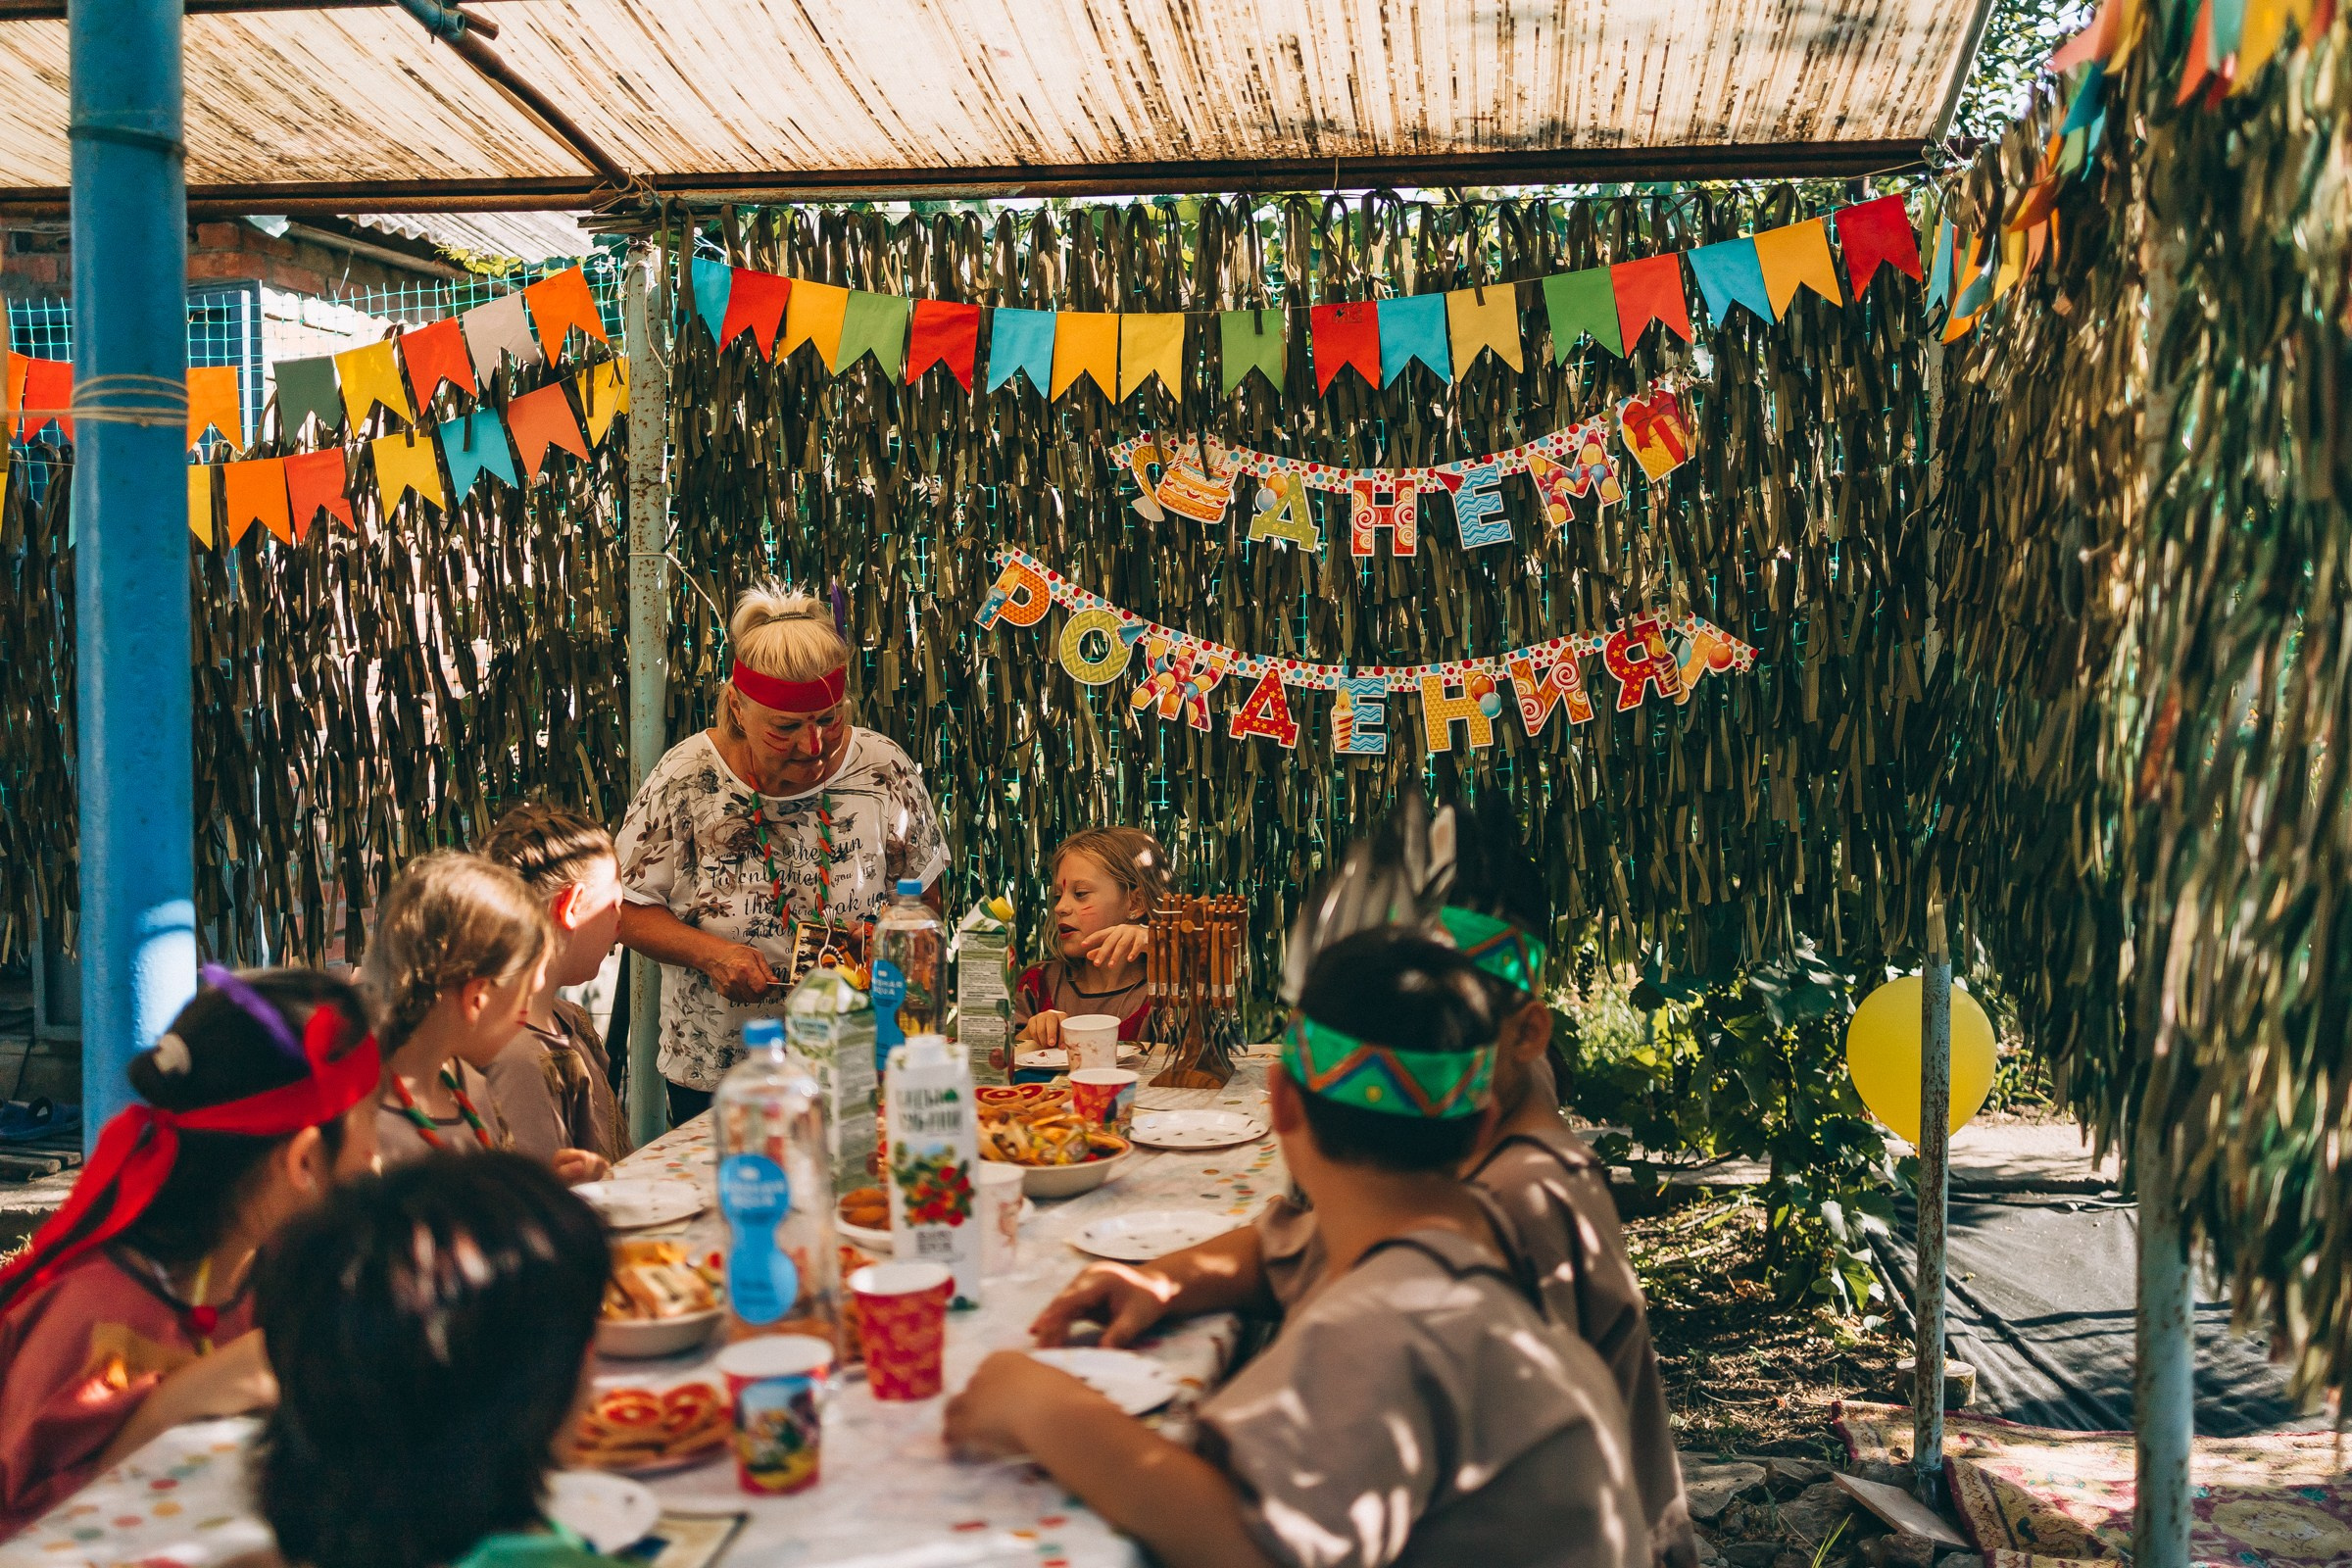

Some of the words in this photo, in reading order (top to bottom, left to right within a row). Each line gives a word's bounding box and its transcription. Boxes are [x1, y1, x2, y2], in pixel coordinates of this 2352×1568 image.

[1248, 427, 1623, 558] ДНЕМ
[792, 838, 820, 860] the
[829, 837, 863, 857] sun
